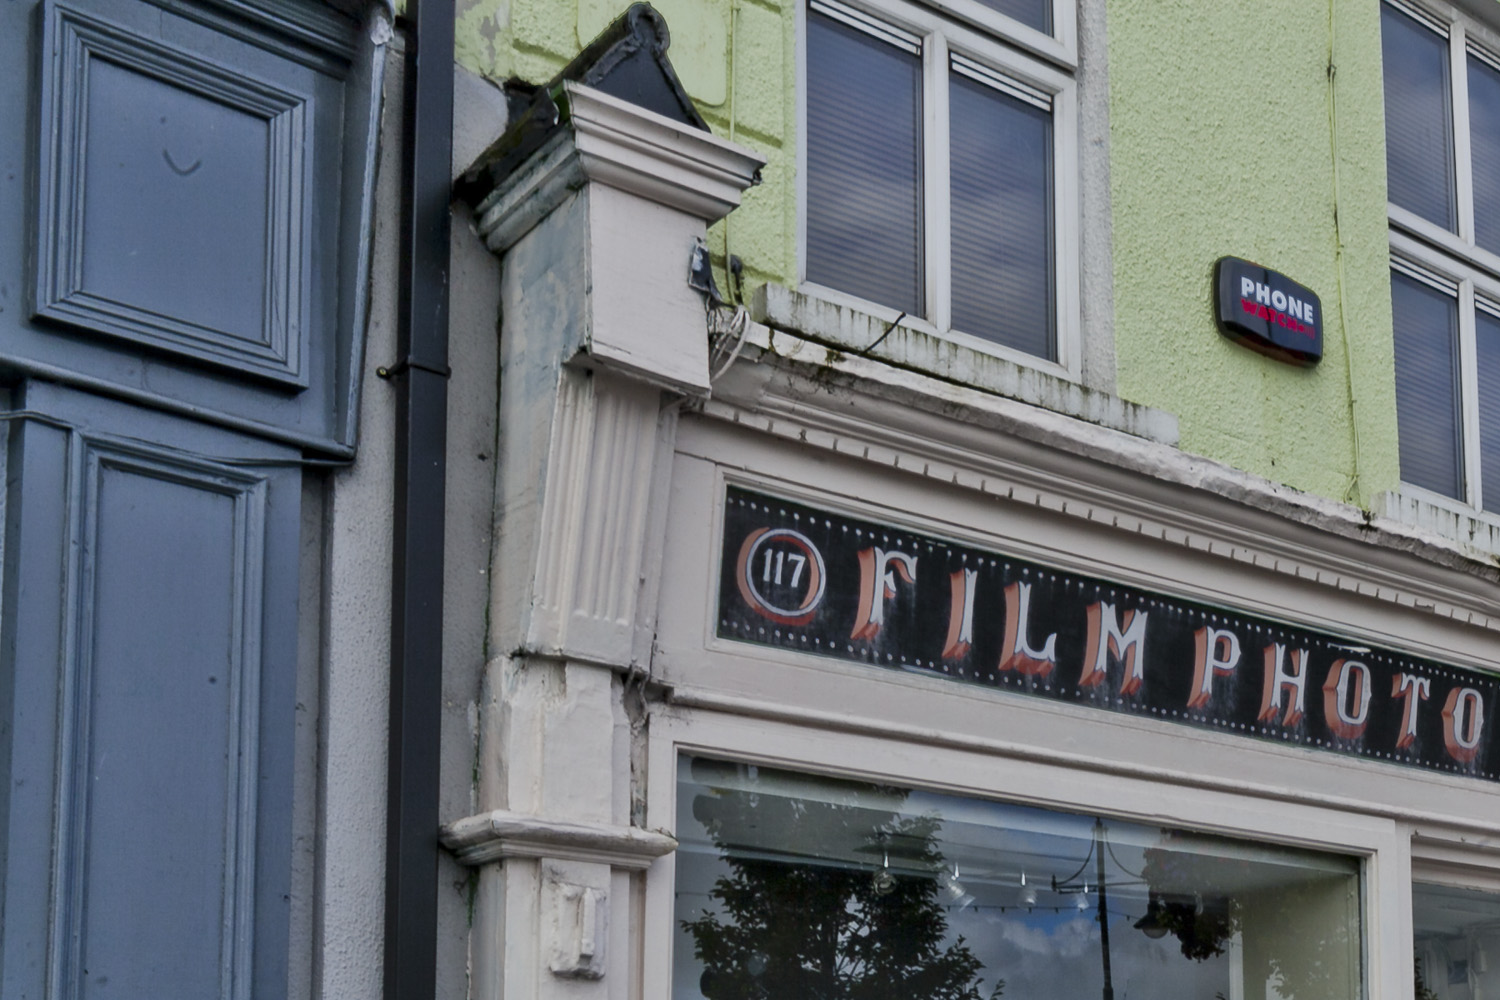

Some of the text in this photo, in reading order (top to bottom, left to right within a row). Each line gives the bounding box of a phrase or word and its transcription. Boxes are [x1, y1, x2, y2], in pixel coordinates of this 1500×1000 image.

[1241, 276, 1313, 325] PHONE
[1241, 298, 1298, 332] WATCH
[762, 548, 805, 588] 117
[852, 546, 1149, 695] FILM
[1188, 624, 1484, 762] PHOTO
